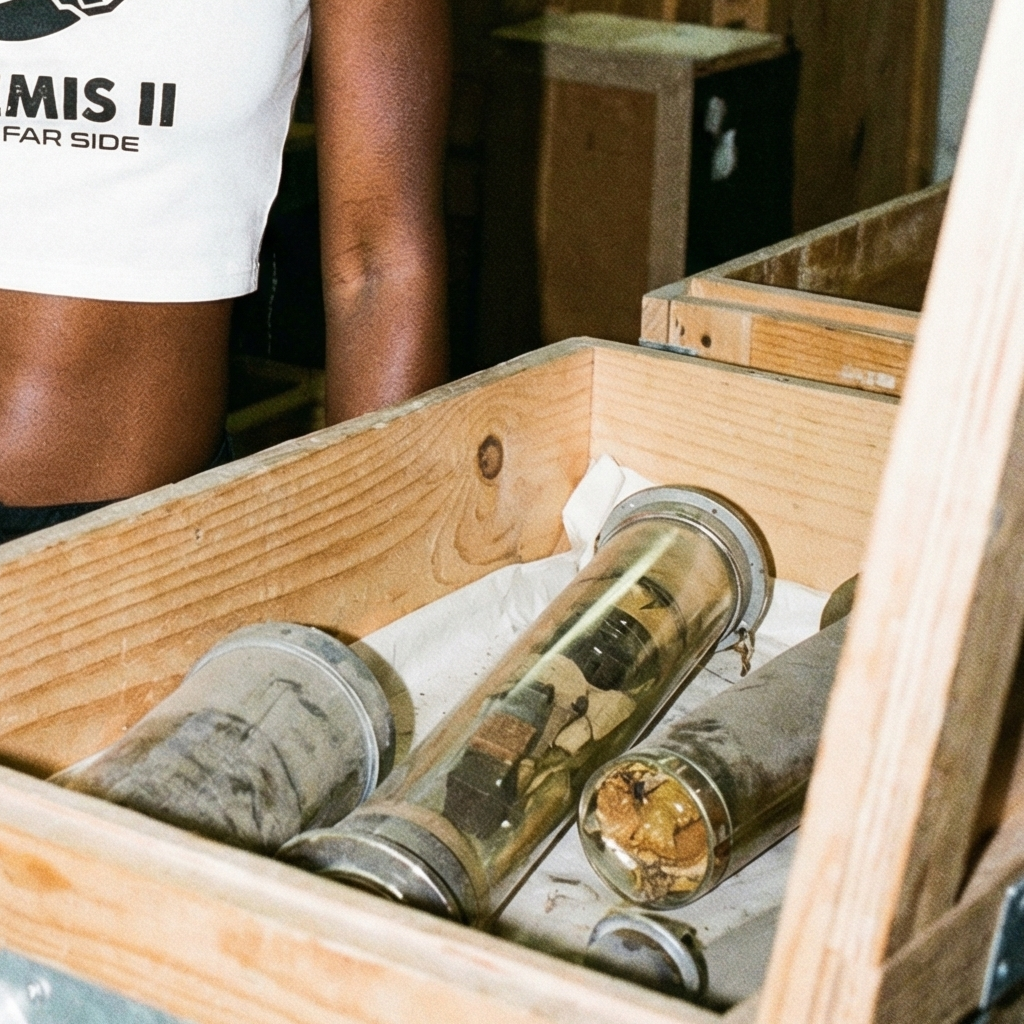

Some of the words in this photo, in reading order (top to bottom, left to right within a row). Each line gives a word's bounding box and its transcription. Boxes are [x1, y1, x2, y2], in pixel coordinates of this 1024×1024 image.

[138, 81, 177, 128] II
[3, 125, 62, 147] FAR
[70, 132, 140, 153] SIDE
